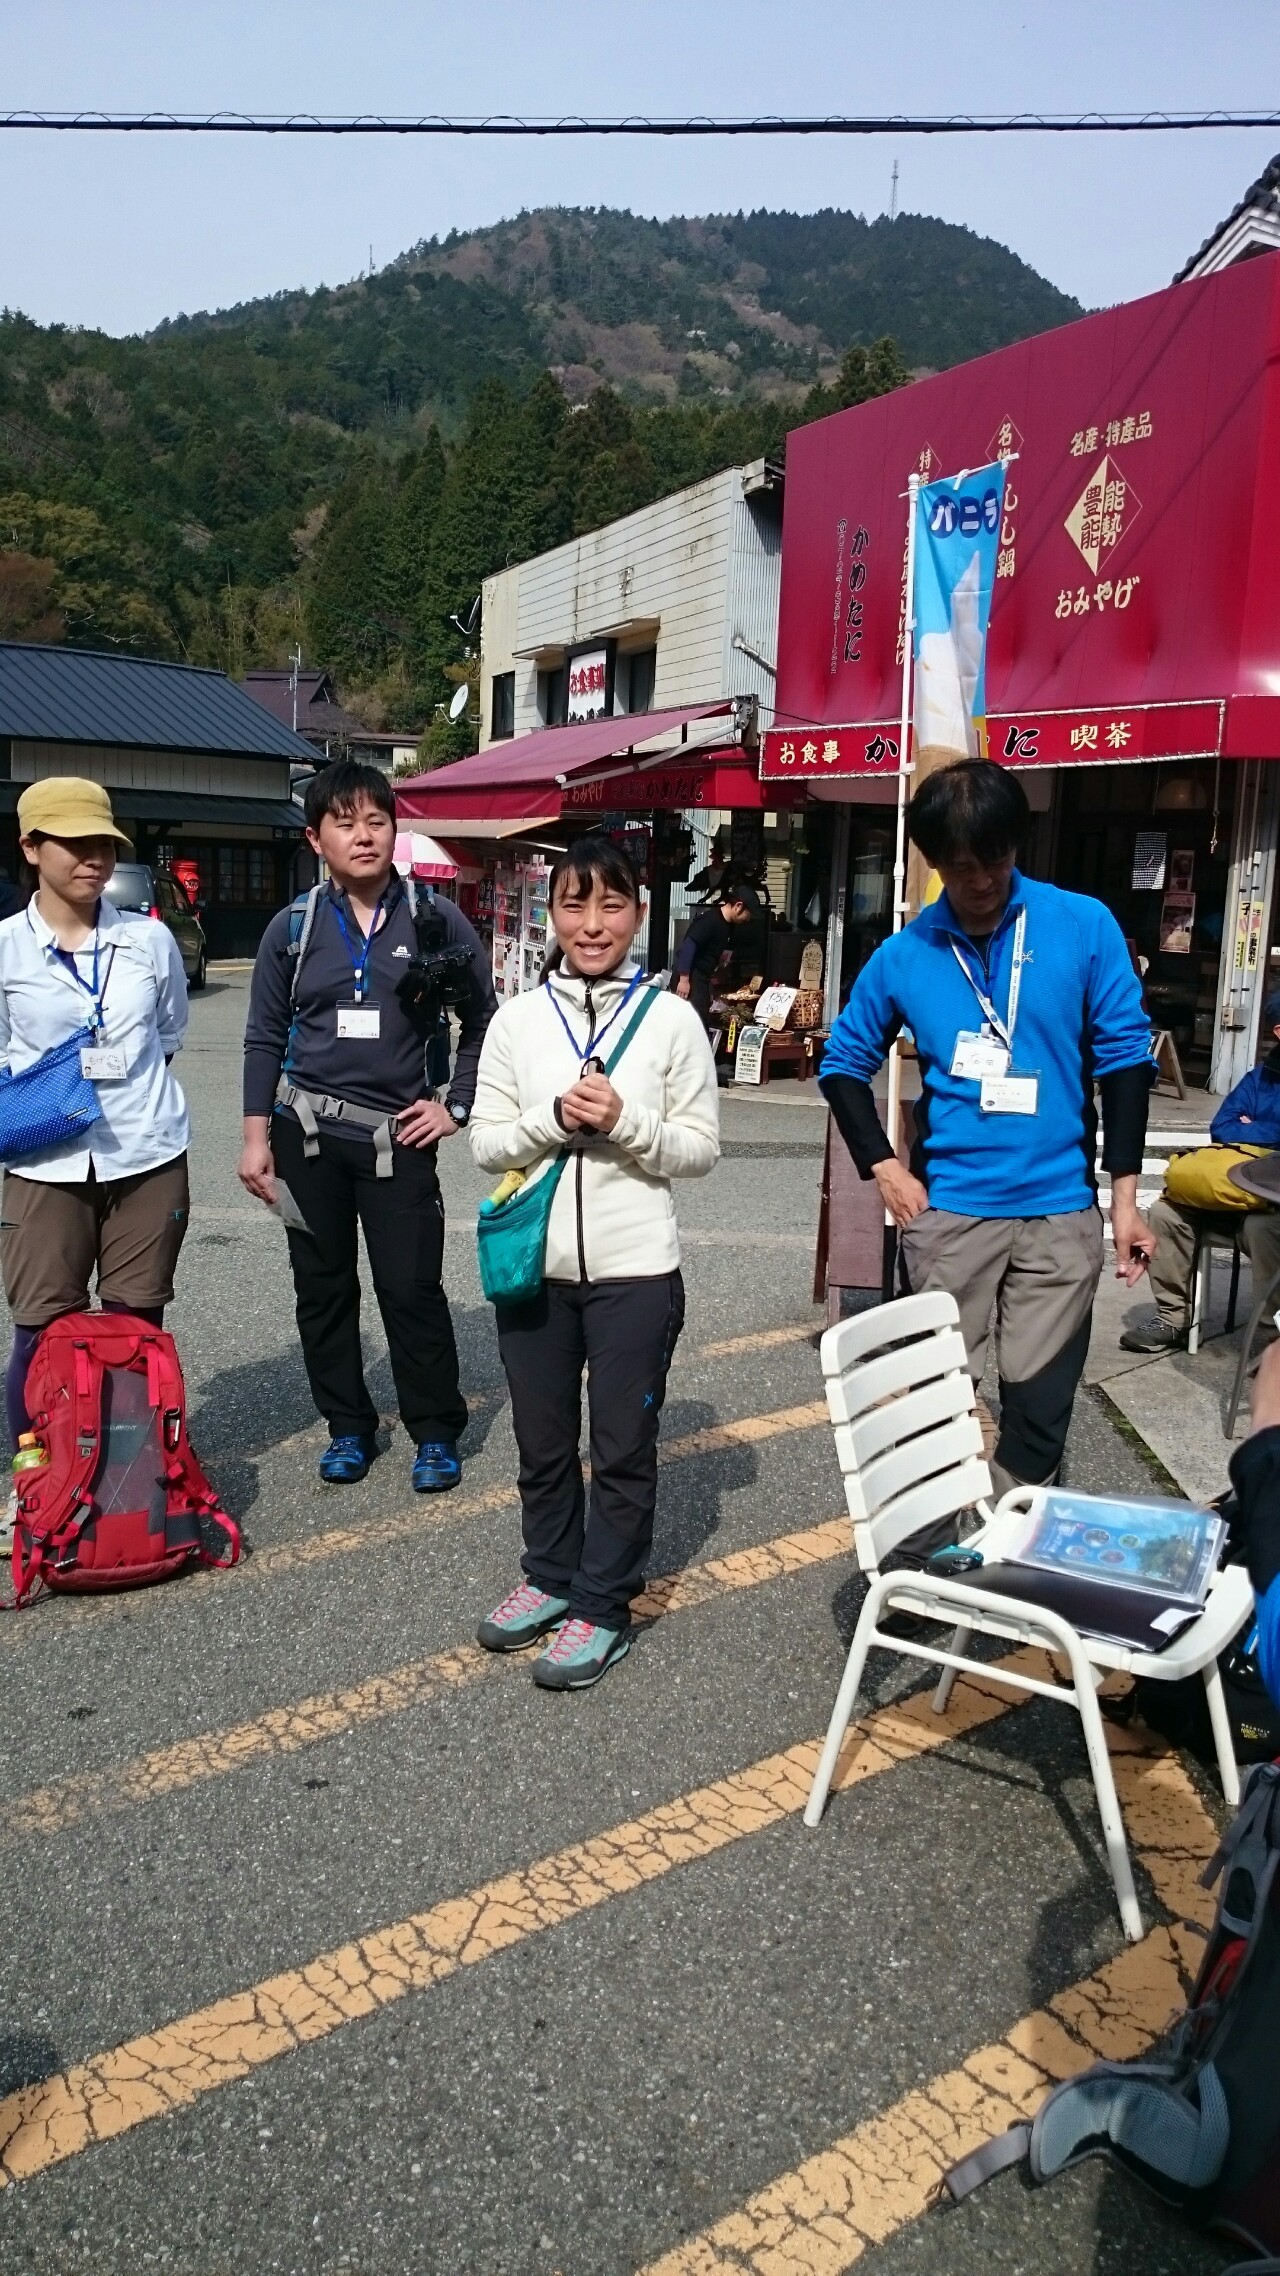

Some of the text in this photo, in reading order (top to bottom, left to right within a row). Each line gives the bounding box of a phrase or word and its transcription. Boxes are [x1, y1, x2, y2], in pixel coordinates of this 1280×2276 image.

[931, 497, 998, 533] バニラ
[844, 524, 870, 664] かめたに
[1054, 575, 1140, 619] おみやげ
[779, 739, 841, 765] お食事
[1069, 721, 1132, 752] 喫茶
